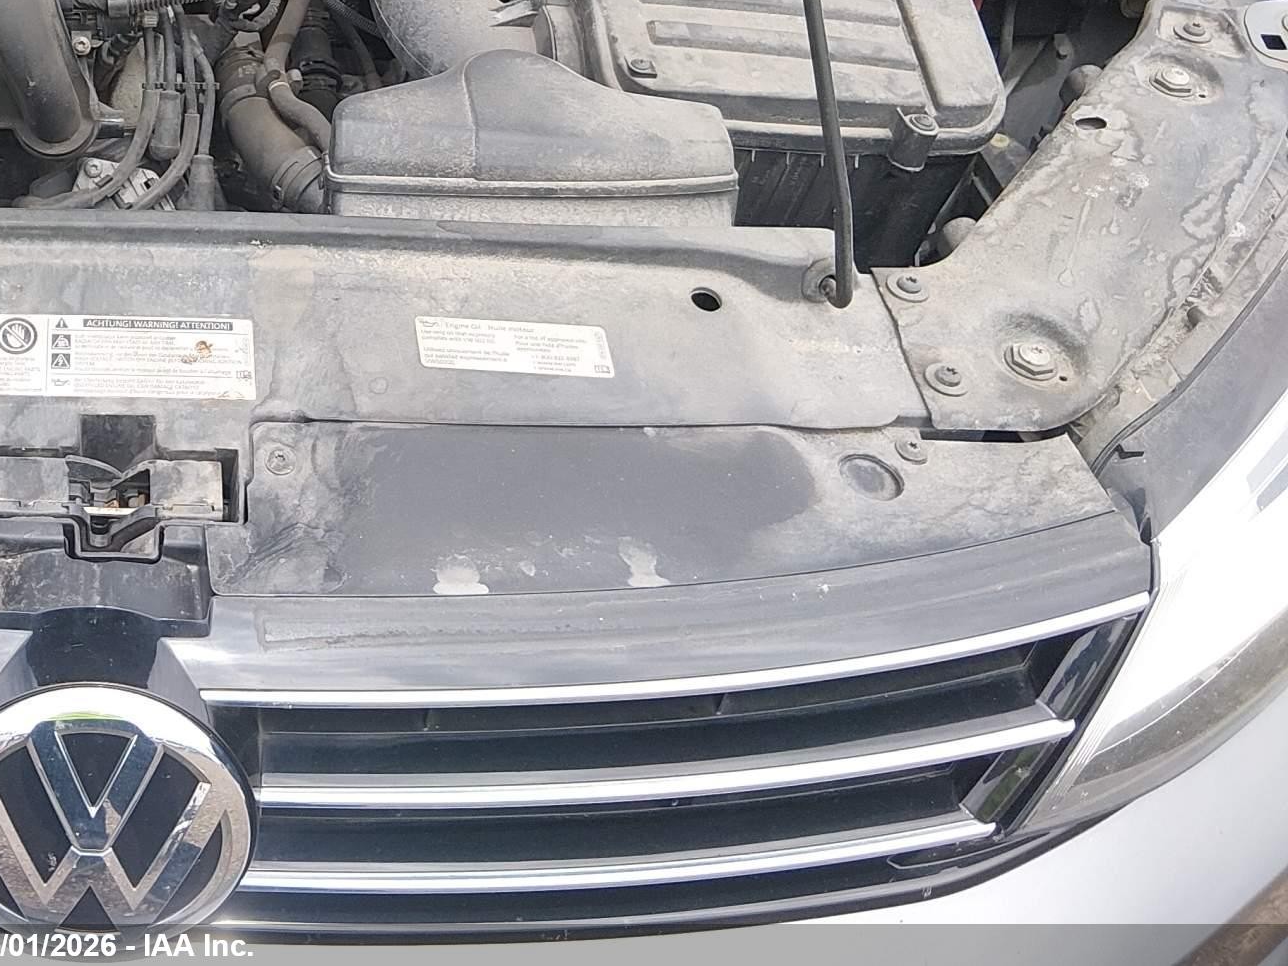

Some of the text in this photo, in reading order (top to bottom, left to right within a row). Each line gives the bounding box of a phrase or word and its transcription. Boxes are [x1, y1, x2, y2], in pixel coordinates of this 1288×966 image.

[86, 319, 231, 331] ACHTUNG! WARNING! ATTENTION!
